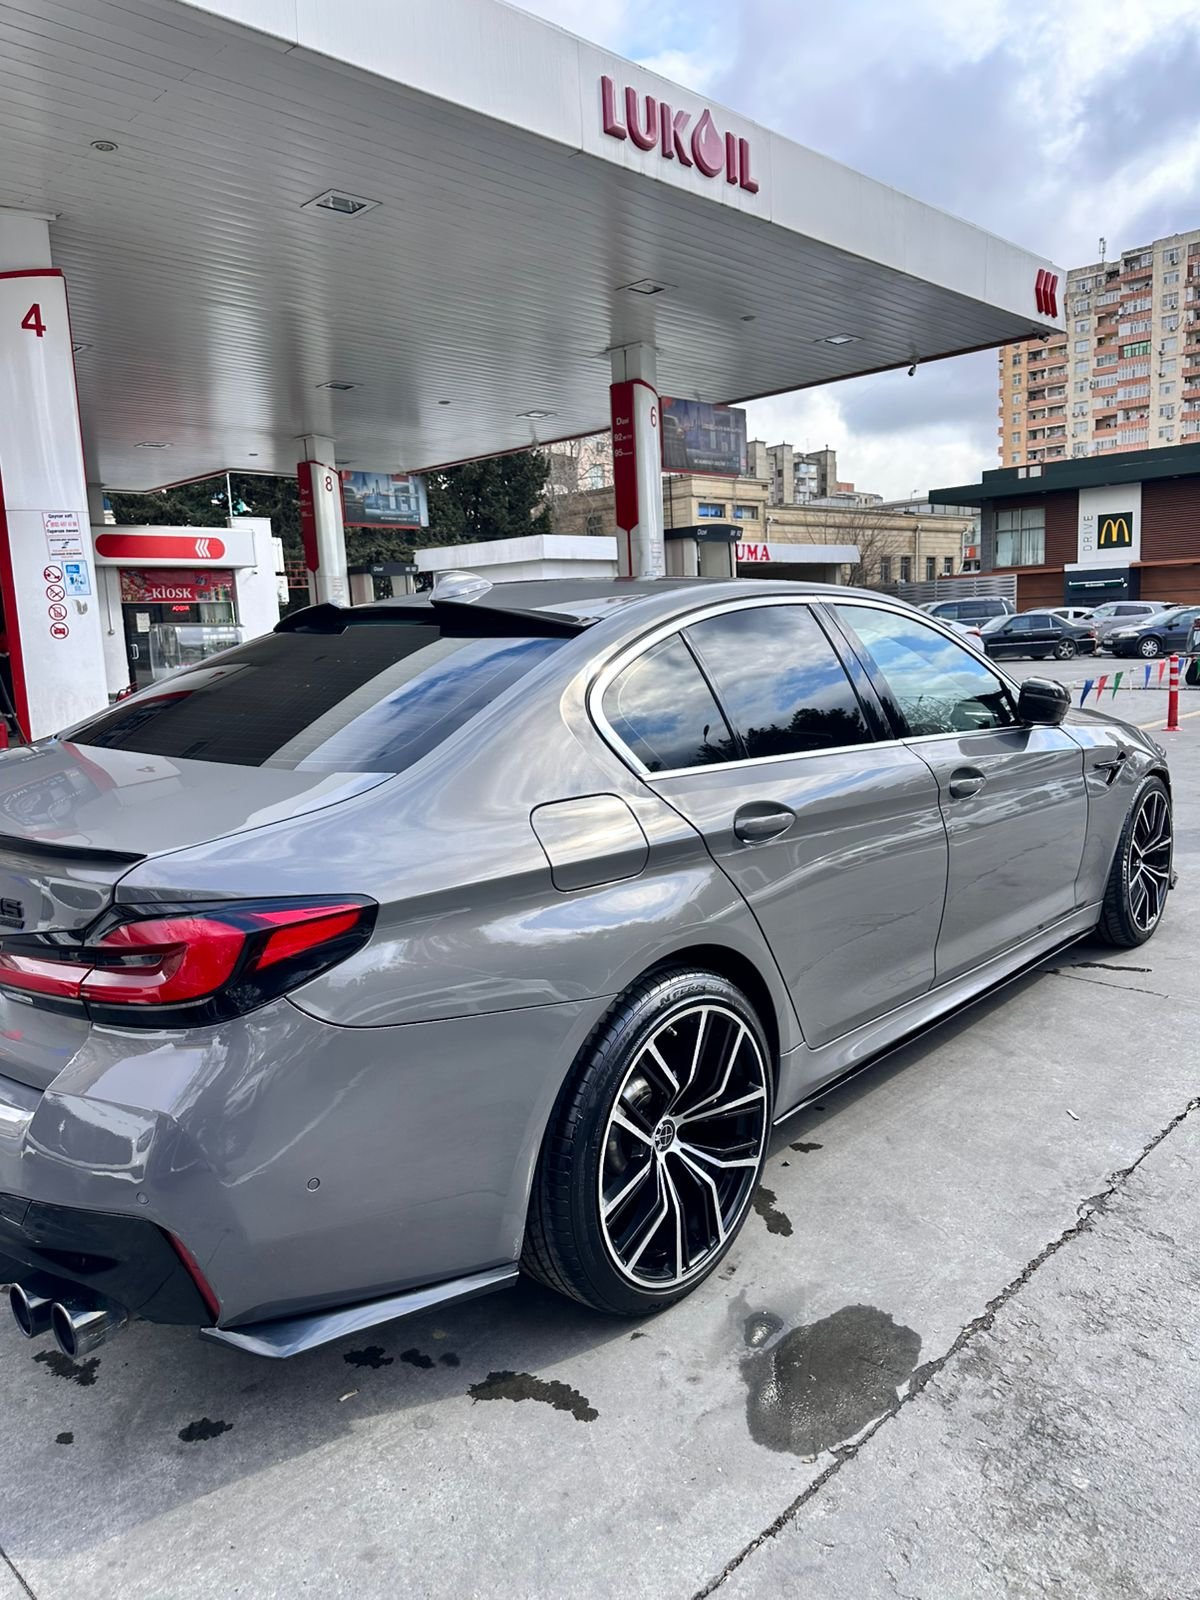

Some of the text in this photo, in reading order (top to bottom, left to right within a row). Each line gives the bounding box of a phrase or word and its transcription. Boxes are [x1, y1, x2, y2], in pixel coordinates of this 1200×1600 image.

[601, 75, 759, 194] LUKOIL
[21, 303, 46, 337] 4
[651, 406, 656, 427] 6
[325, 476, 333, 492] 8
[1083, 515, 1093, 551] DRIVE
